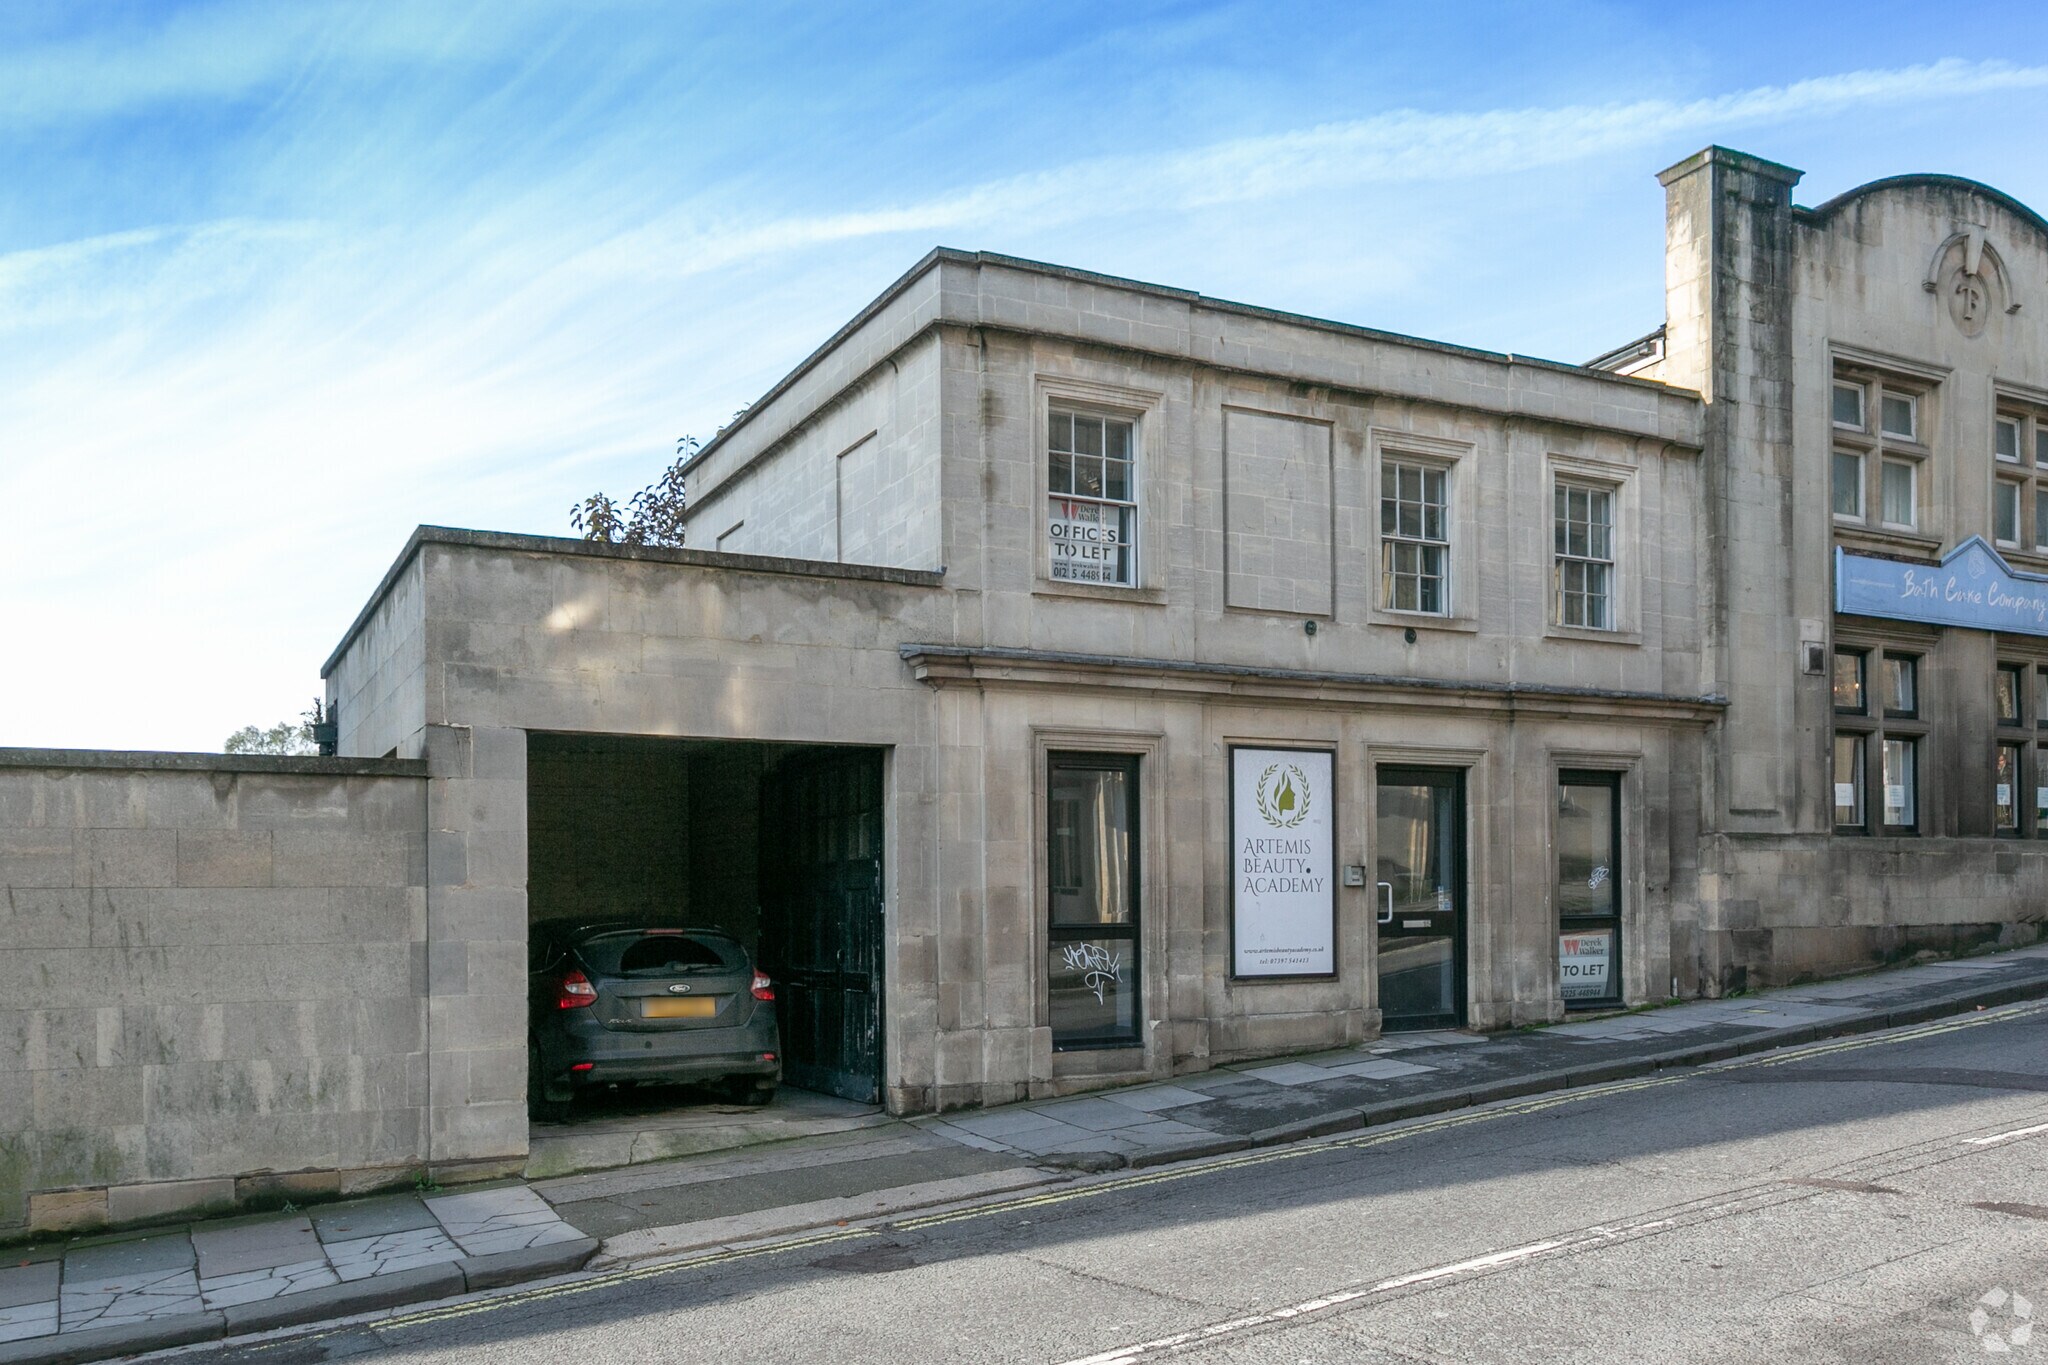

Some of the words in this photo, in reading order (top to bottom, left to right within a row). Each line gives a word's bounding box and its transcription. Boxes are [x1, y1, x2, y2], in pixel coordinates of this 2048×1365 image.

[1080, 504, 1100, 514] Dere
[1055, 542, 1077, 557] TO
[1082, 545, 1111, 560] LET
[1053, 567, 1077, 579] 0125
[1901, 569, 1938, 599] Bath
[1988, 581, 2047, 622] Company
[1243, 837, 1311, 858] ARTEMIS
[1243, 876, 1324, 897] ACADEMY
[1562, 965, 1579, 977] TO
[1582, 964, 1604, 976] LET
